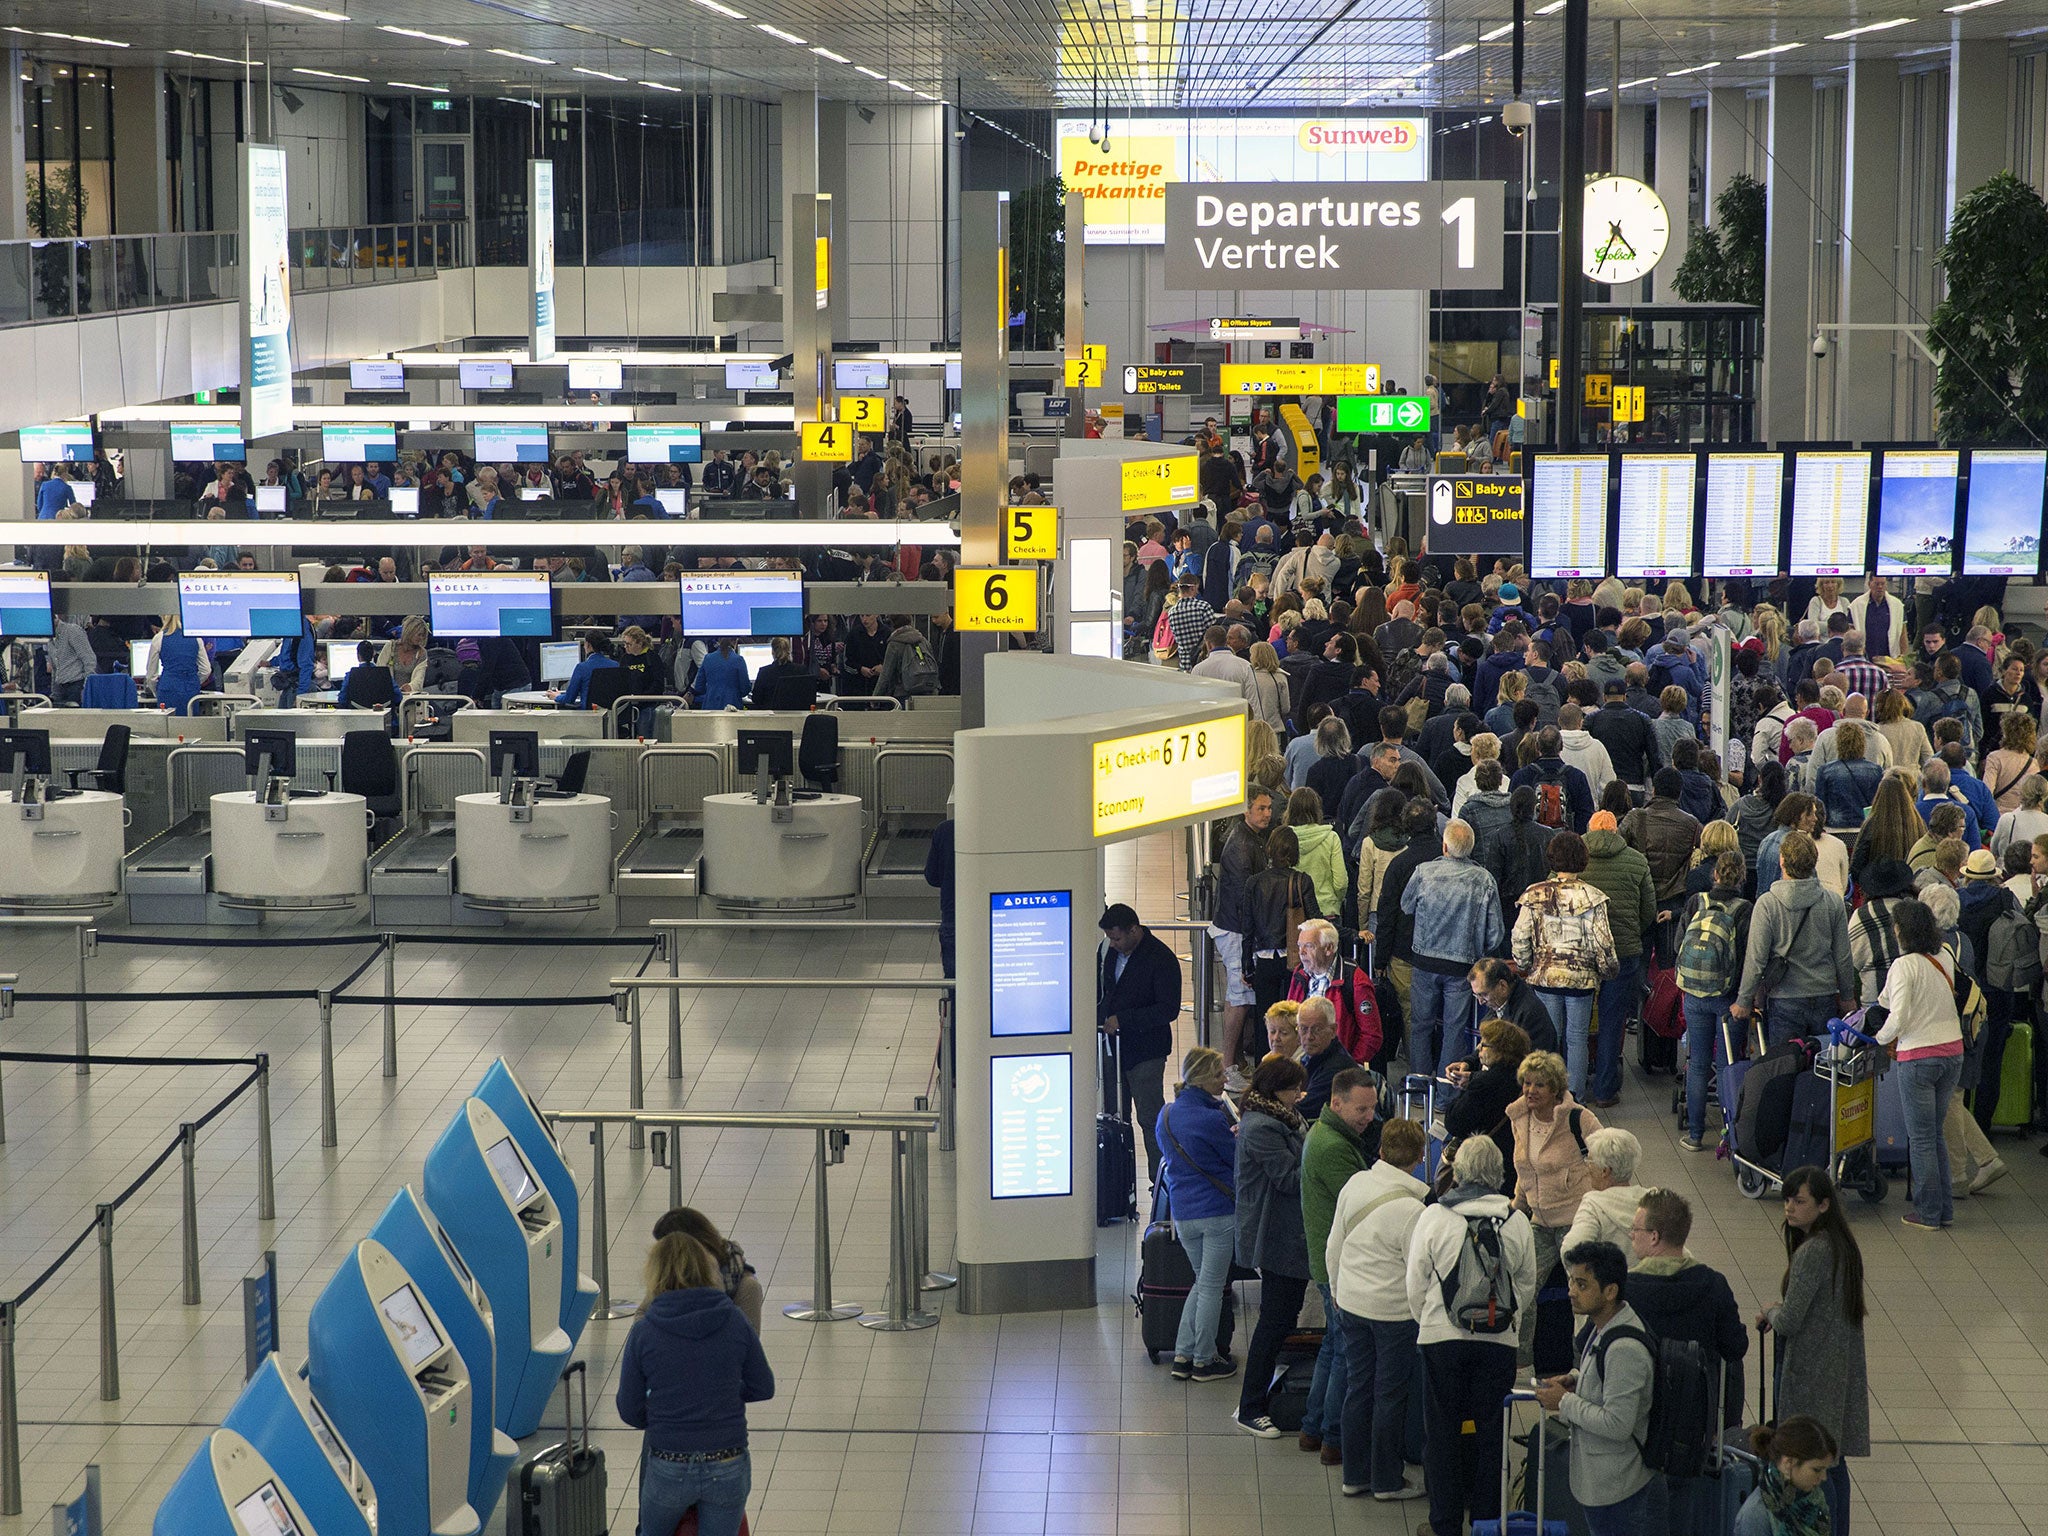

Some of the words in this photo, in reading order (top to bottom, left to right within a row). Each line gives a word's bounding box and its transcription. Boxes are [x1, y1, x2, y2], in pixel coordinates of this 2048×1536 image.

[1309, 126, 1408, 144] Sunweb
[1074, 160, 1162, 179] Prettige
[1196, 195, 1421, 235] Departures
[1441, 197, 1475, 268] 1
[1194, 235, 1340, 269] Vertrek
[1595, 247, 1636, 263] Grolsch
[1250, 320, 1272, 328] Skyport
[1086, 348, 1092, 359] 1
[1078, 362, 1089, 378] 2
[1150, 368, 1167, 378] Baby
[1157, 383, 1181, 391] Toilets
[1279, 383, 1304, 391] Parking
[855, 400, 869, 420] 3
[1048, 400, 1066, 408] LOT
[183, 435, 204, 443] flights
[334, 435, 355, 443] flights
[486, 435, 507, 443] flights
[818, 426, 835, 448] 4
[1133, 469, 1155, 478] Check-in
[1156, 464, 1161, 478] 4
[1165, 464, 1170, 478] 5
[1475, 483, 1506, 497] Baby
[1509, 485, 1522, 495] ca
[1123, 493, 1147, 502] Economy
[1490, 508, 1524, 520] Toilet
[1013, 512, 1033, 542] 5
[288, 573, 294, 582] 3
[539, 573, 545, 581] 2
[792, 572, 797, 580] 1
[984, 574, 1008, 611] 6
[985, 615, 1024, 624] Check-in
[1116, 746, 1160, 769] Check-in
[1163, 738, 1172, 765] 6
[1180, 735, 1189, 762] 7
[1197, 731, 1207, 758] 8
[1098, 796, 1145, 818] Economy
[1014, 896, 1048, 905] DELTA
[1841, 1096, 1869, 1120] Sunweb
